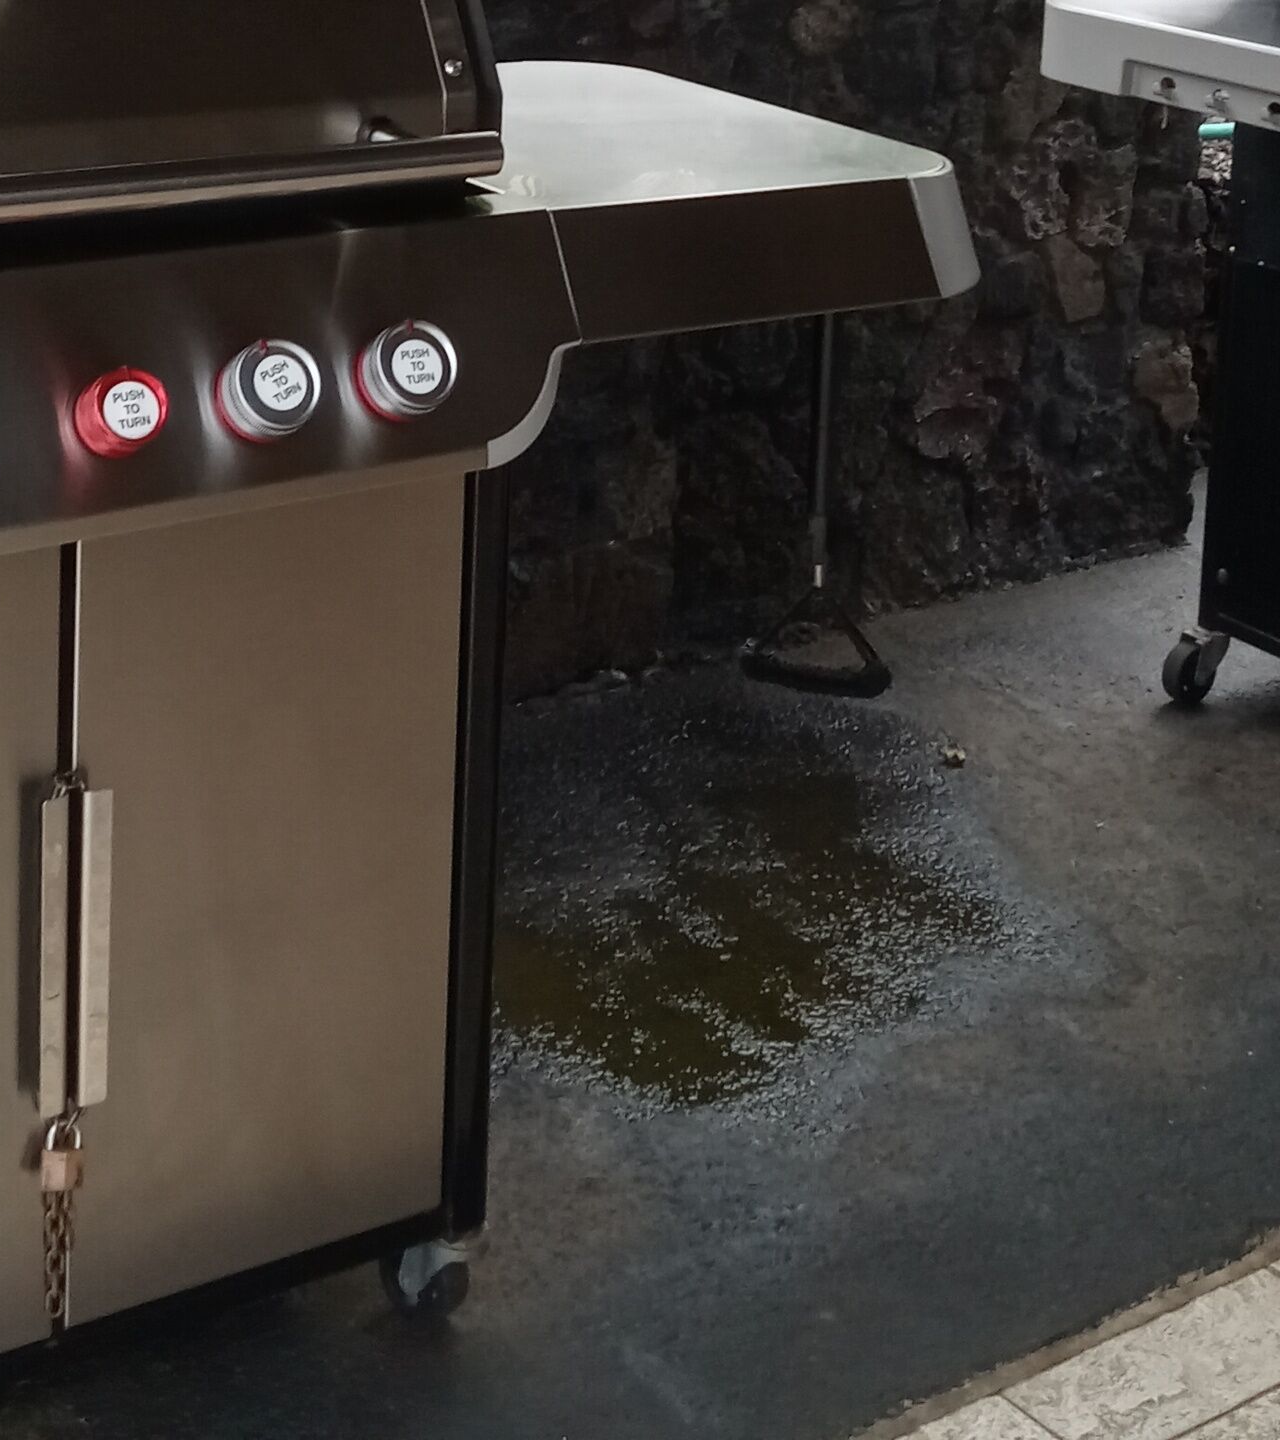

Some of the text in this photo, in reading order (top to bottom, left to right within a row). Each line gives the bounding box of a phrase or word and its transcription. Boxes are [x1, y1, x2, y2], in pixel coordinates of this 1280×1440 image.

[401, 348, 430, 360] PUSH
[260, 360, 289, 381] PUSH
[410, 361, 425, 372] TO
[272, 375, 288, 388] TO
[406, 372, 435, 384] TURN
[112, 389, 145, 404] PUSH
[272, 381, 302, 403] TURN
[123, 403, 140, 414] TO
[118, 415, 151, 429] TURN
